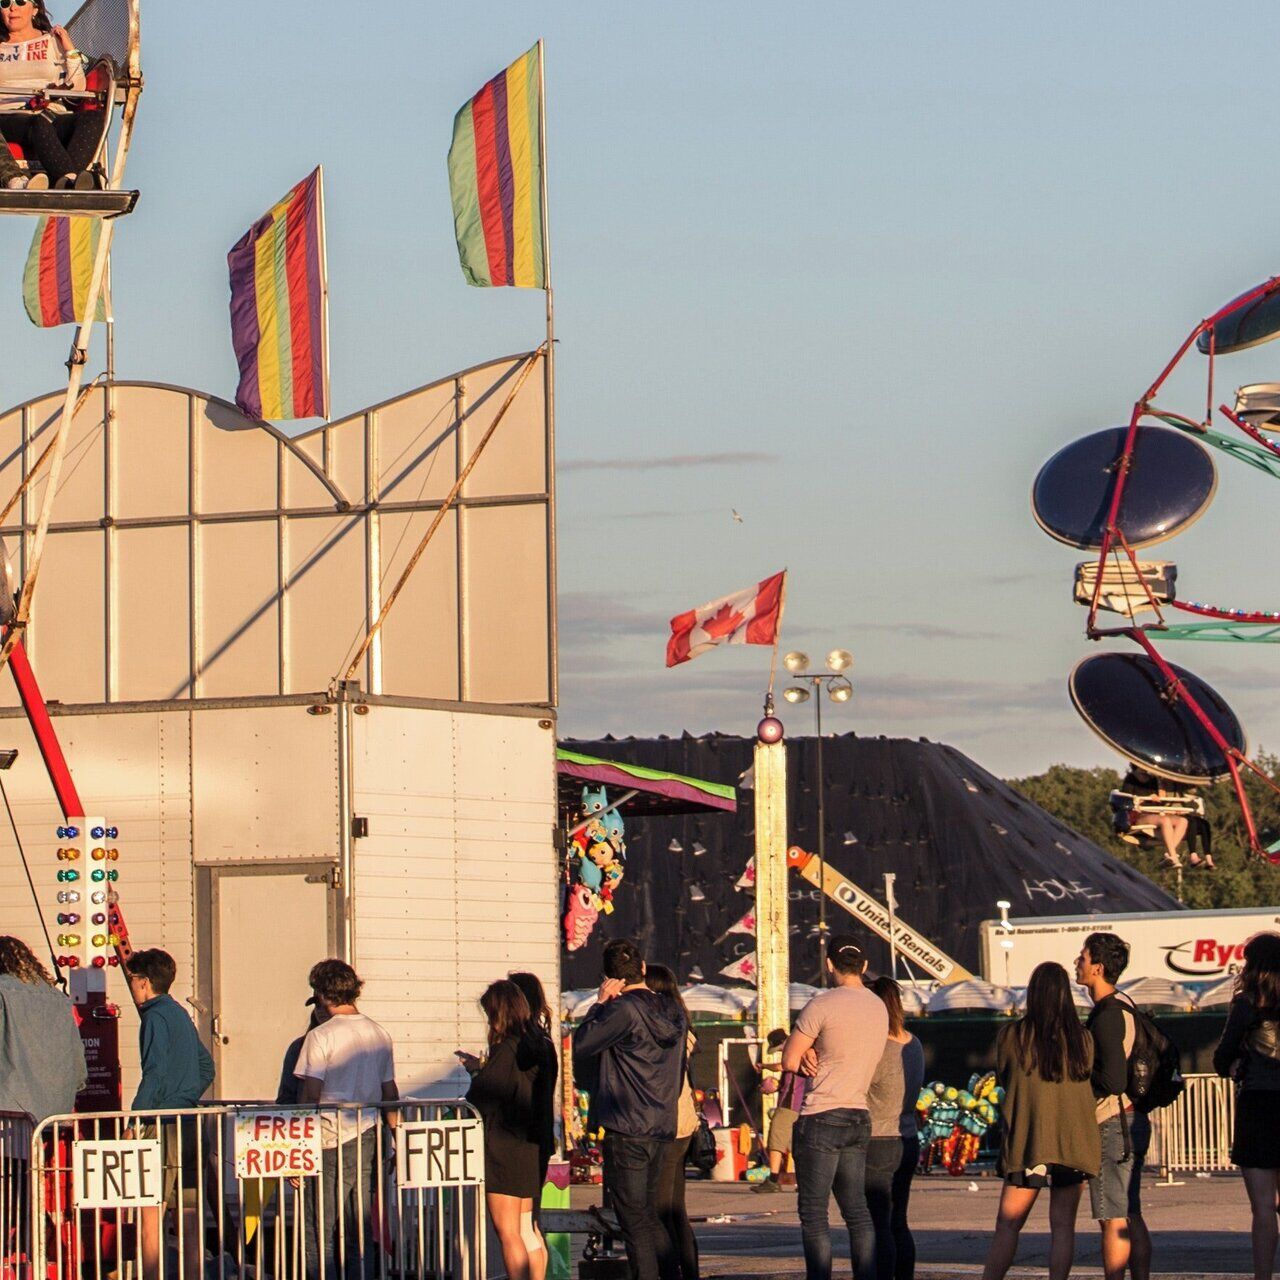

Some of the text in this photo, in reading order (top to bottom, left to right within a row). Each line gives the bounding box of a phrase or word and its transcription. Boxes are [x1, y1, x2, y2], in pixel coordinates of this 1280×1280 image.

[898, 932, 946, 973] Rentals
[253, 1115, 316, 1141] FREE
[81, 1147, 155, 1200] FREE
[246, 1147, 316, 1176] RIDES
[405, 1125, 478, 1183] FREE
